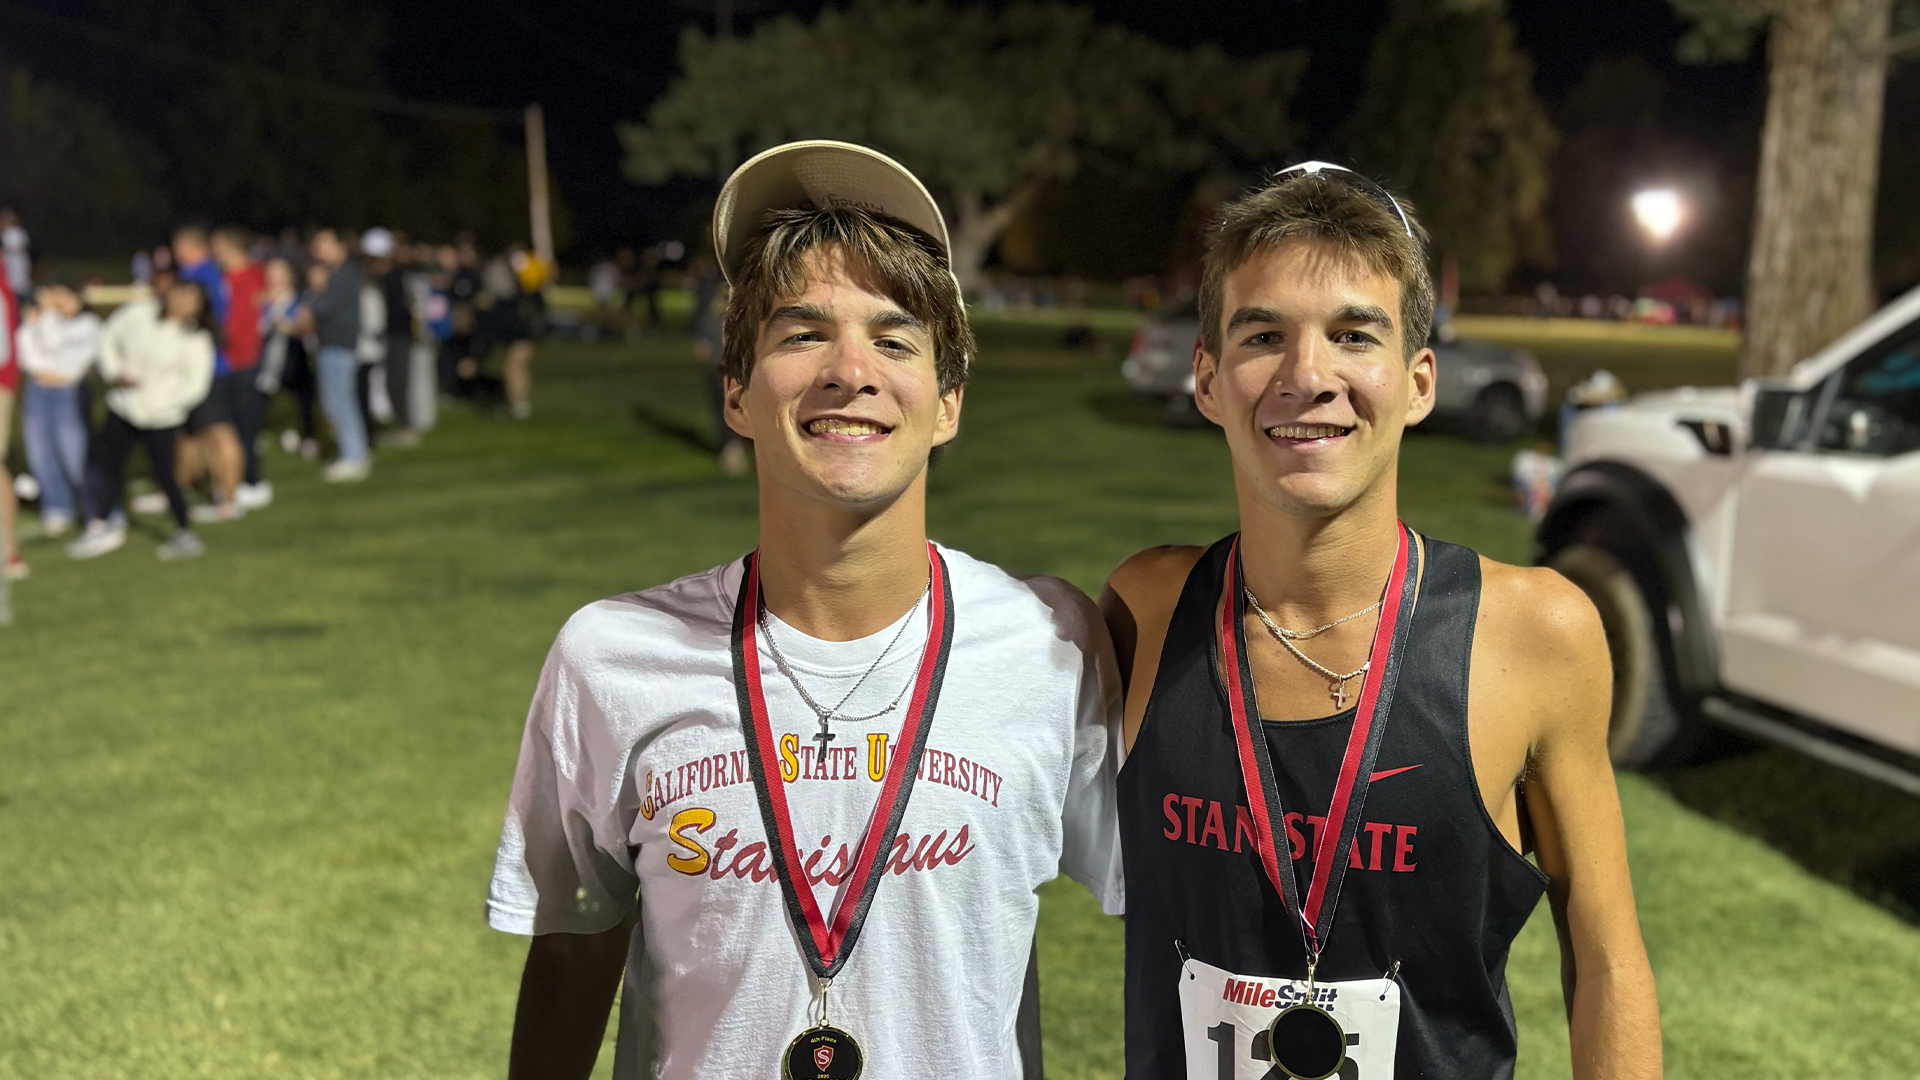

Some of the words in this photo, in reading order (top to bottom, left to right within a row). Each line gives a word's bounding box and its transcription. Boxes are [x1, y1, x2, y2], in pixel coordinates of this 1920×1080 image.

[641, 749, 753, 821] CALIFORN
[779, 733, 857, 782] STATE
[867, 734, 1003, 808] UVERSITY
[667, 807, 976, 886] Staisaus
[1163, 793, 1260, 854] STAN
[817, 1049, 830, 1065] S
